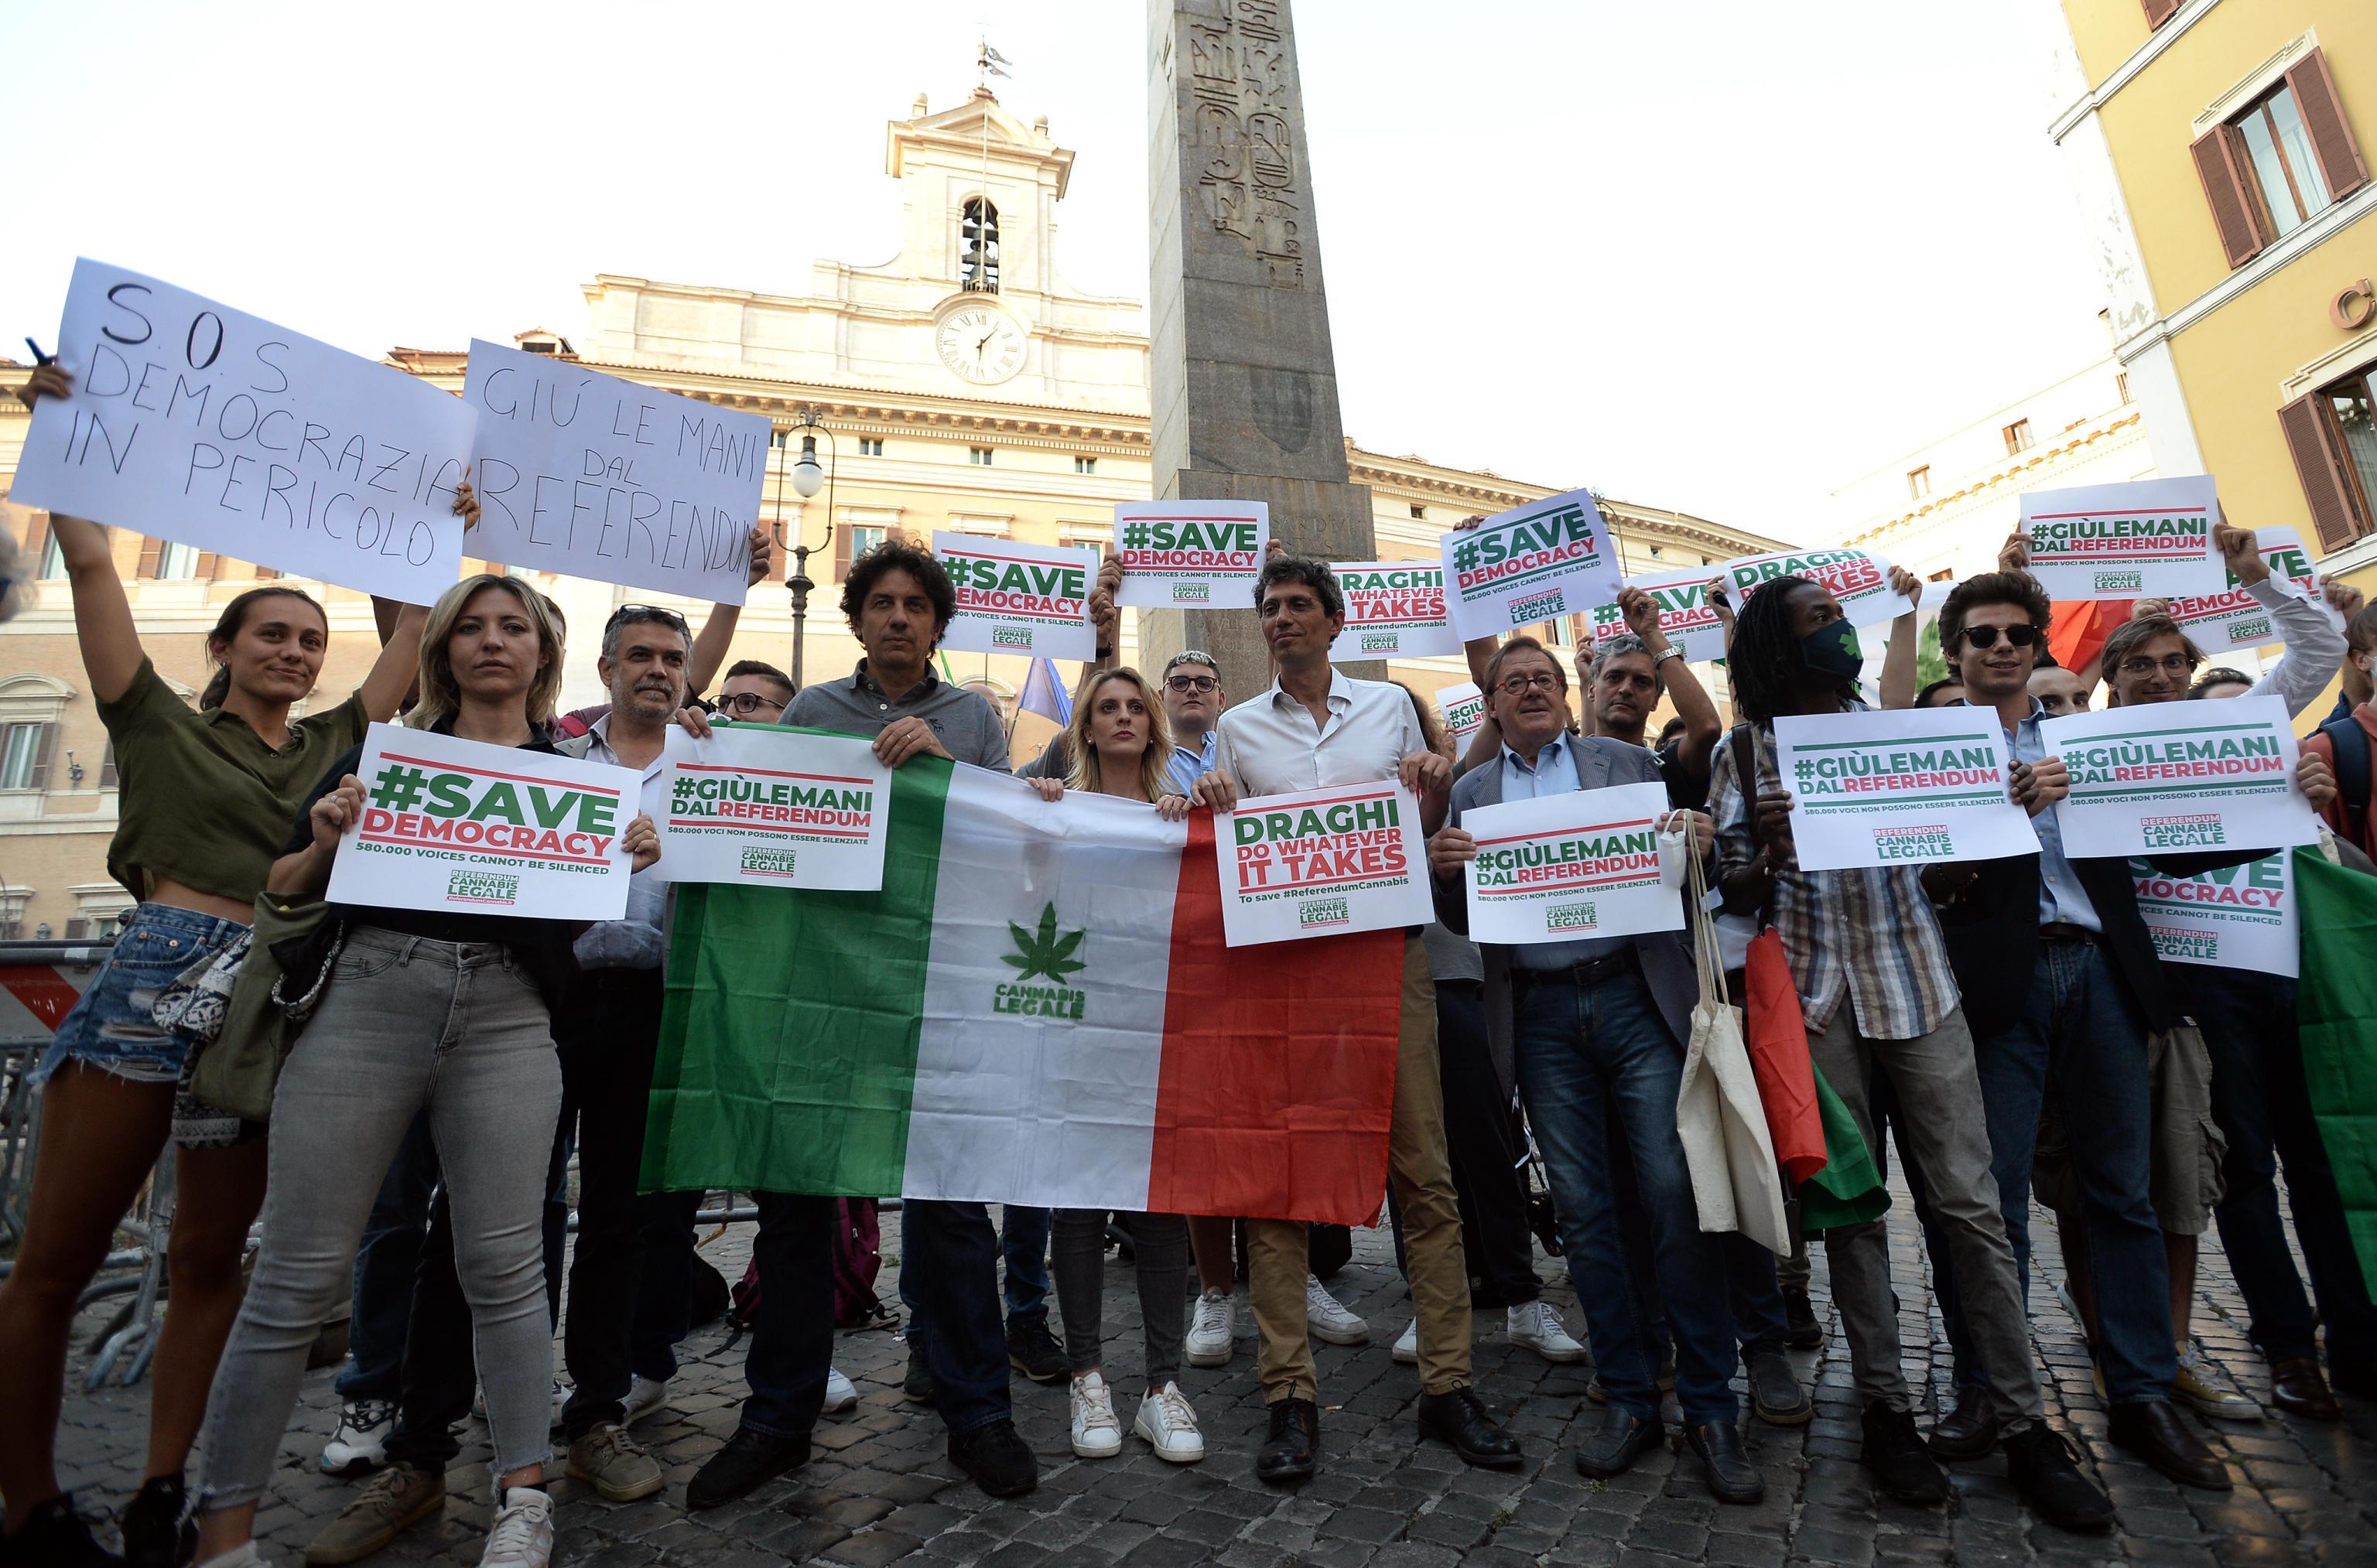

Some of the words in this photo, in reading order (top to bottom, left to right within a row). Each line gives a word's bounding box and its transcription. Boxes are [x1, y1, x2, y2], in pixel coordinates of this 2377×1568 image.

[84, 343, 462, 508] DEMOCRAZIA
[613, 400, 656, 445] LE
[678, 415, 757, 482] MANI
[583, 449, 641, 486] DAL
[65, 410, 139, 475] IN
[184, 443, 435, 566] PERICOLO
[1124, 522, 1258, 551] #SAVE
[2031, 518, 2206, 540] #GIÙLEMANI
[1454, 509, 1592, 573] #SAVE
[2031, 536, 2206, 552] DALREFERENDUM
[1124, 550, 1257, 565] DEMOCRACY
[1458, 537, 1595, 589] DEMOCRACY
[942, 557, 1085, 599] #SAVE
[1493, 582, 1519, 594] VOICES
[1520, 574, 1551, 586] CANNOT
[1565, 561, 1601, 574] SILENCED
[1732, 550, 1867, 589] DRAGHI
[1342, 571, 1443, 590] RAGHI
[1818, 565, 1881, 593] KES
[956, 588, 1084, 613] EMOCRACY
[1348, 588, 1444, 600] WHATEVER
[1352, 597, 1446, 619] TAKES
[1510, 595, 1563, 613] CANNABIS
[1511, 602, 1565, 624] LEGALE
[1048, 619, 1084, 627] SILENCED
[2201, 613, 2231, 623] VOICES
[2234, 606, 2262, 617] CANNO
[1351, 620, 1446, 631] #ReferendumCannabis
[2228, 621, 2269, 633] CANNABIS
[2230, 627, 2272, 640] LEGALE
[993, 636, 1031, 645] LEGALE
[2064, 736, 2281, 770] #GIÙLEMANI
[1794, 747, 1997, 780] #GIÙLEMANI
[2067, 756, 2283, 785] DALREFERENDUM
[1799, 768, 2001, 794] DALREFERENDUM
[369, 764, 619, 836] #SAVE
[672, 774, 873, 811] #GIÙLEMANI
[2071, 798, 2105, 806] 580.000
[2153, 792, 2197, 801] POSSONO
[2199, 789, 2233, 798] ESSERE
[2235, 786, 2288, 795] SILENZIATE
[670, 799, 871, 827] DALREFERENDUM
[1882, 803, 1923, 811] POSSONO
[1958, 798, 2006, 807] SILENZIATE
[1233, 799, 1400, 845] DRAGHI
[2141, 814, 2221, 826] REFERENDUM
[2143, 822, 2222, 835] CANNABIS
[361, 808, 615, 857] DEMOCRACY
[747, 831, 788, 840] POSSONO
[1873, 825, 1948, 837] REFERENDUM
[1876, 834, 1951, 846] CANNABIS
[2144, 832, 2227, 848] LEGALE
[1237, 843, 1270, 861] DO
[1275, 828, 1402, 856] WHATEVER
[1476, 832, 1657, 872] #GIÙLEMANI
[1877, 842, 1955, 859] LEGALE
[356, 842, 412, 856] 580.000
[416, 849, 466, 862] VOICES
[470, 855, 525, 867] CANNOT
[528, 860, 545, 869] BE
[548, 863, 609, 875] SILENCED
[740, 859, 795, 873] LEGALE
[742, 852, 795, 863] CANNABIS
[1238, 859, 1272, 887] IT
[1281, 844, 1407, 881] TAKES
[451, 869, 519, 882] REFERENDUM
[1476, 852, 1659, 886] DALREFERENDUM
[447, 884, 517, 900] LEGALE
[450, 877, 518, 890] CANNABIS
[1239, 895, 1253, 904] To
[1255, 893, 1281, 902] save
[1284, 876, 1409, 899] #ReferendumCannabis
[1548, 888, 1585, 897] POSSONO
[1616, 879, 1661, 889] SILENZIATE
[1298, 897, 1347, 909] REFERENDUM
[1299, 904, 1348, 915] CANNABIS
[1300, 910, 1349, 924] LEGALE
[1548, 908, 1595, 919] CANNABIS
[1548, 915, 1597, 928] LEGALE
[2166, 909, 2210, 919] CANNOT
[2230, 914, 2282, 925] SILENCED
[2149, 926, 2218, 939] EFERENDUM
[2152, 934, 2218, 948] ANNABIS
[2154, 943, 2218, 959] EGALE
[993, 996, 1085, 1019] LEGALE
